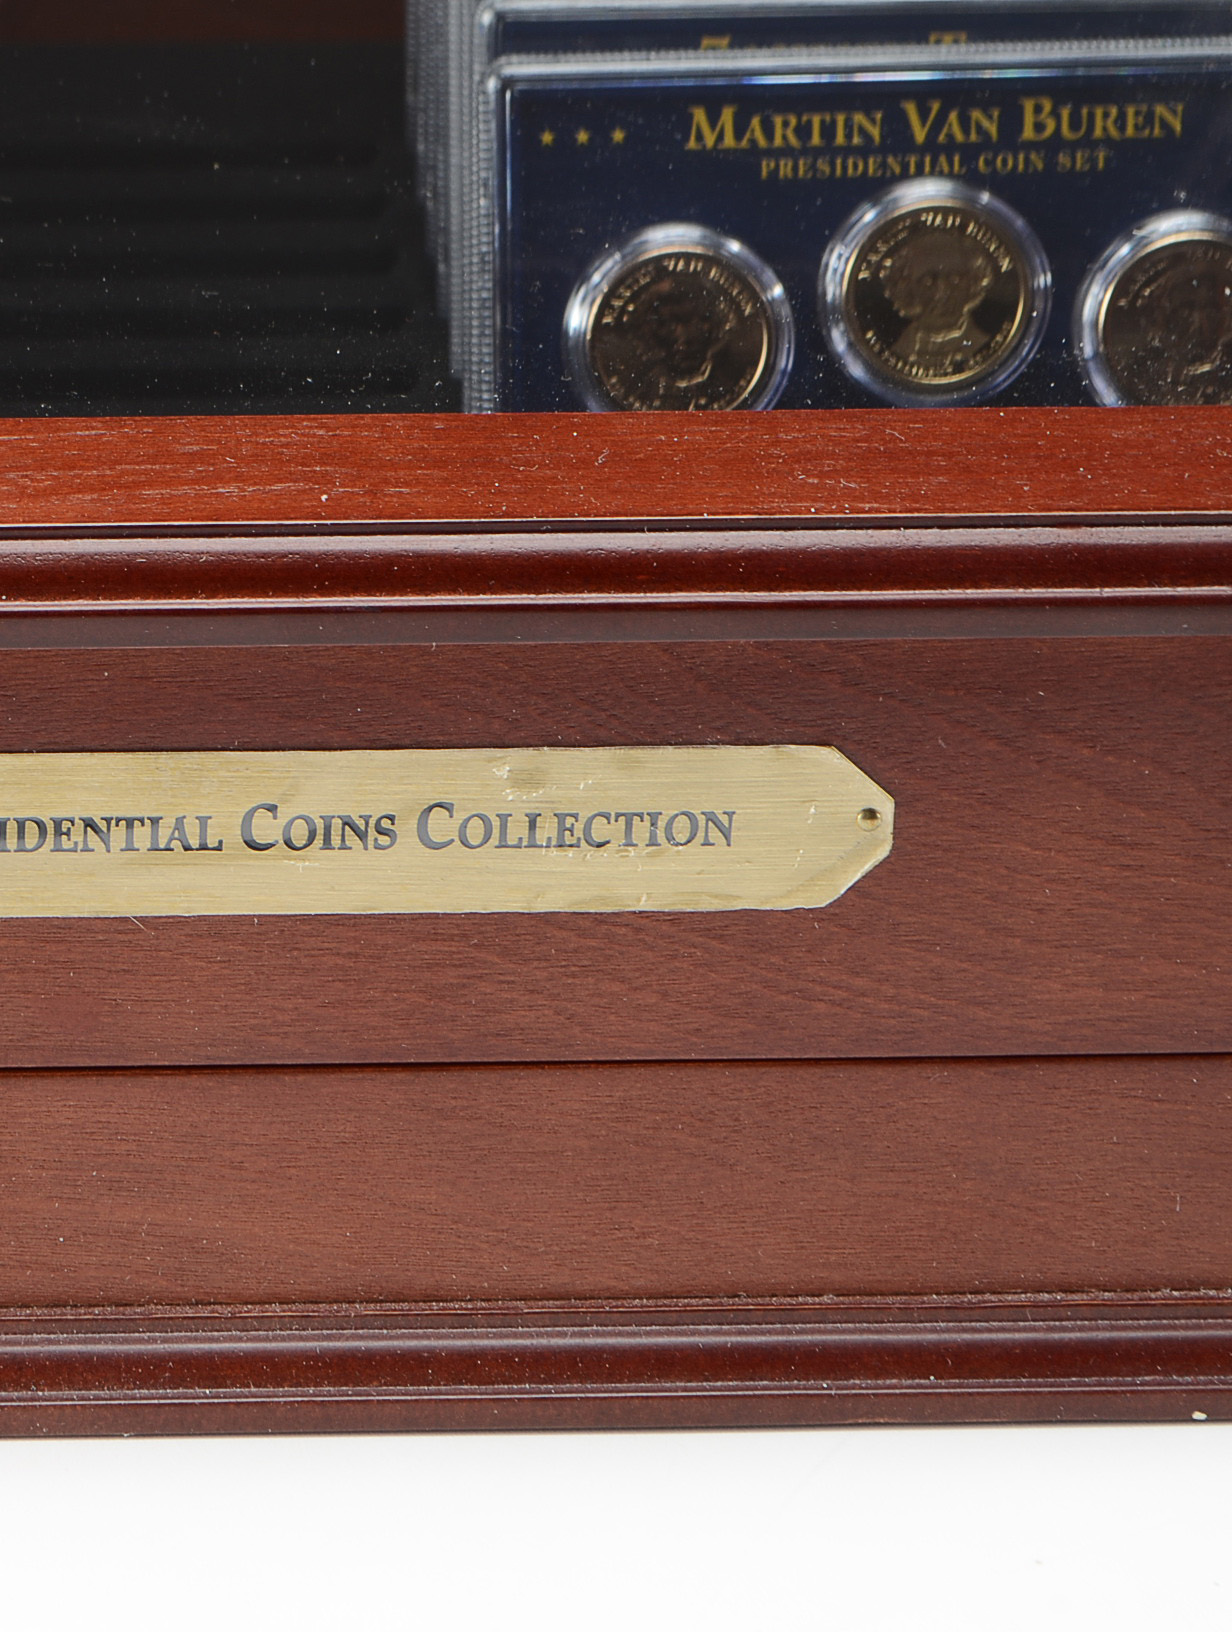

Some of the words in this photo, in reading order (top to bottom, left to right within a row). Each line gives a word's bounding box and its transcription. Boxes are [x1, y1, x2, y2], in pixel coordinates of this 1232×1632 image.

[686, 105, 882, 150] MARTIN
[902, 100, 1000, 144] VAN
[1021, 96, 1184, 141] BUREN
[761, 153, 963, 179] PRESIDENTIAL
[978, 152, 1044, 173] COIN
[1058, 150, 1106, 171] SET
[241, 804, 396, 851] COINS
[417, 802, 735, 850] COLLECTION
